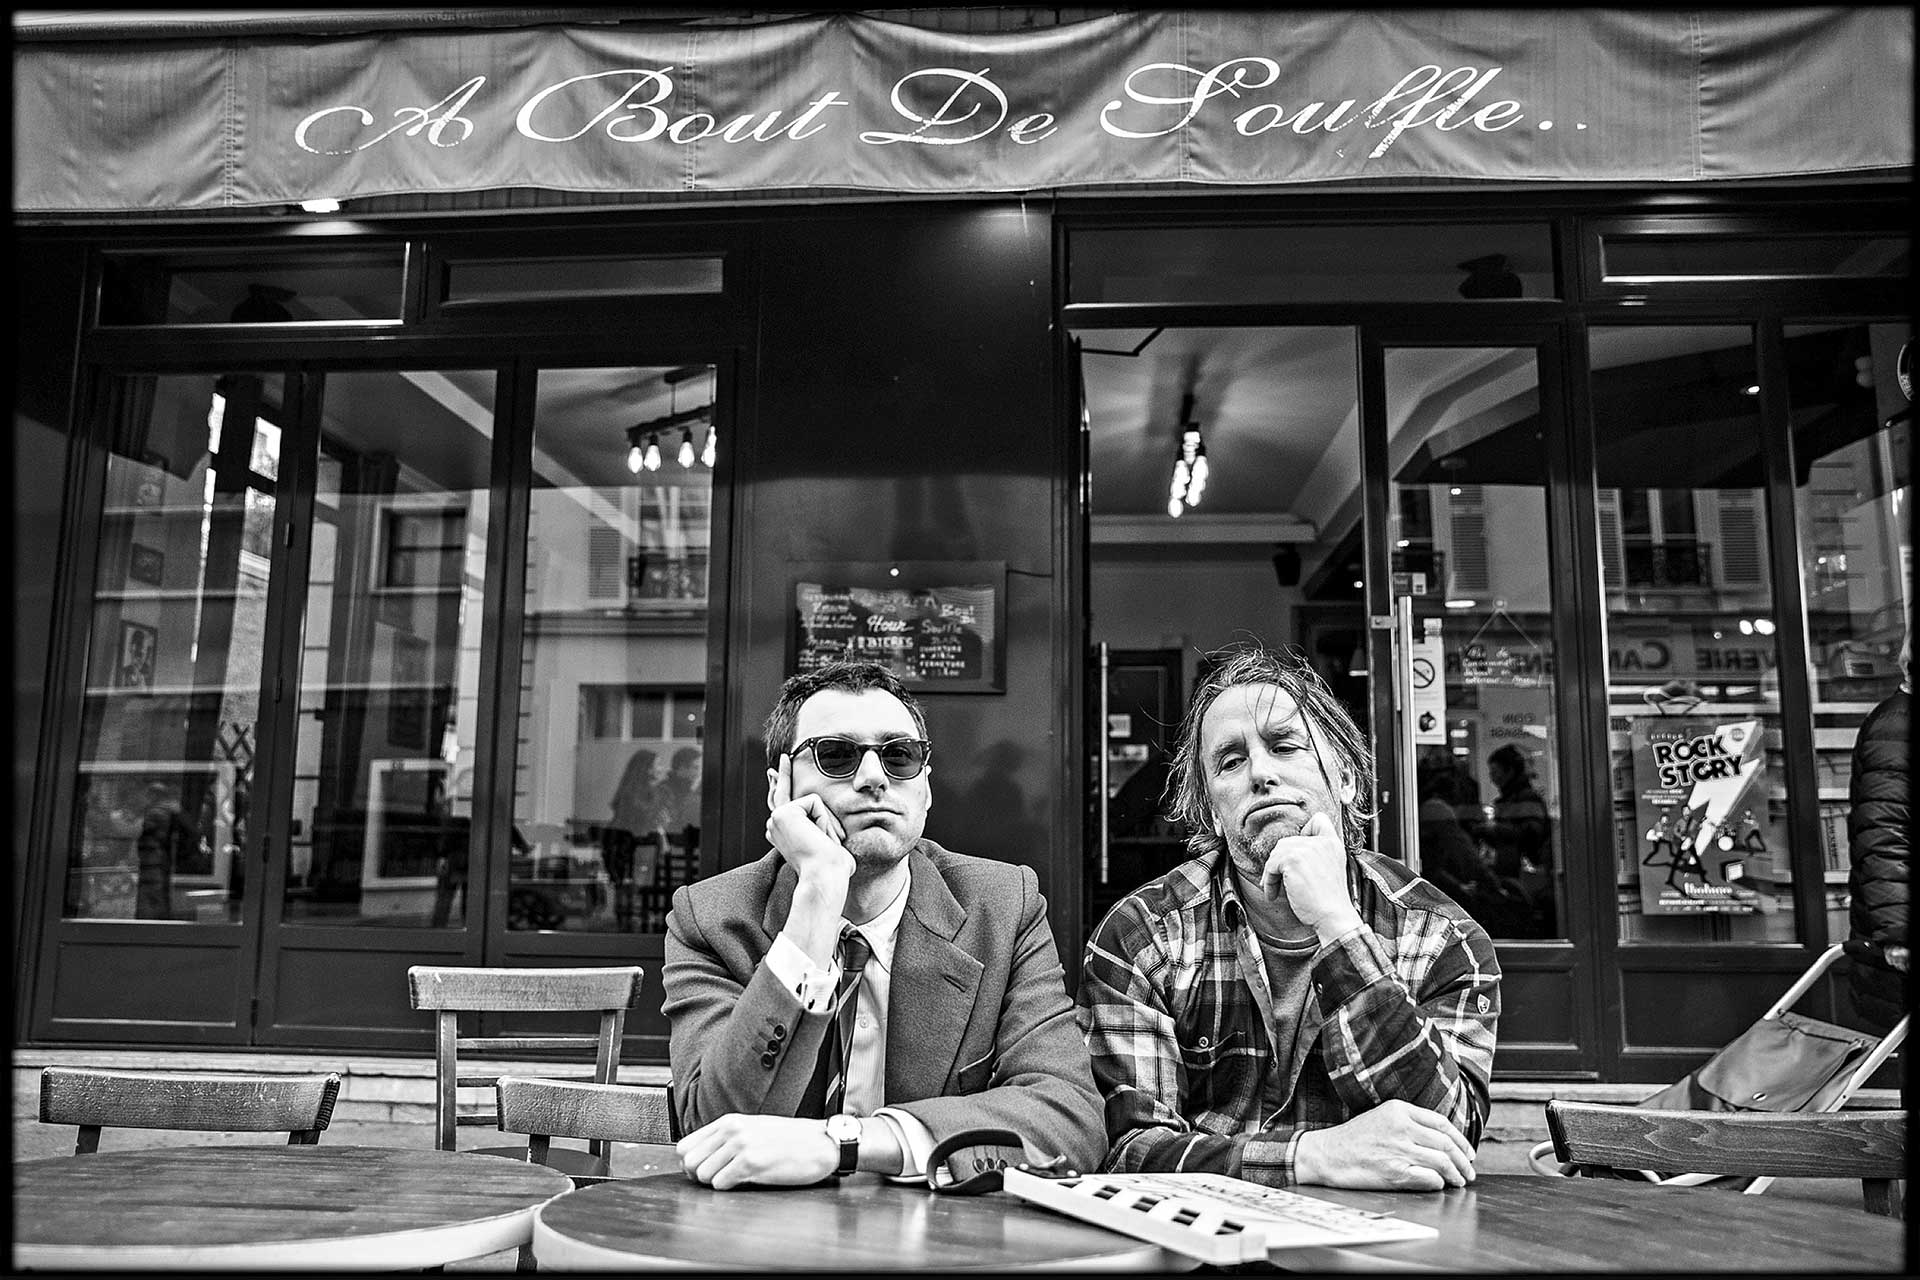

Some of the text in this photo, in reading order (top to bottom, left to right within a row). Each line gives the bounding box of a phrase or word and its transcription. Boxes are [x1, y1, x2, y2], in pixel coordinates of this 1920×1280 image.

[294, 76, 486, 156] A
[515, 66, 849, 145] Bout
[858, 67, 1058, 146] De
[1653, 734, 1728, 767] ROCK
[1659, 754, 1743, 789] STORY
